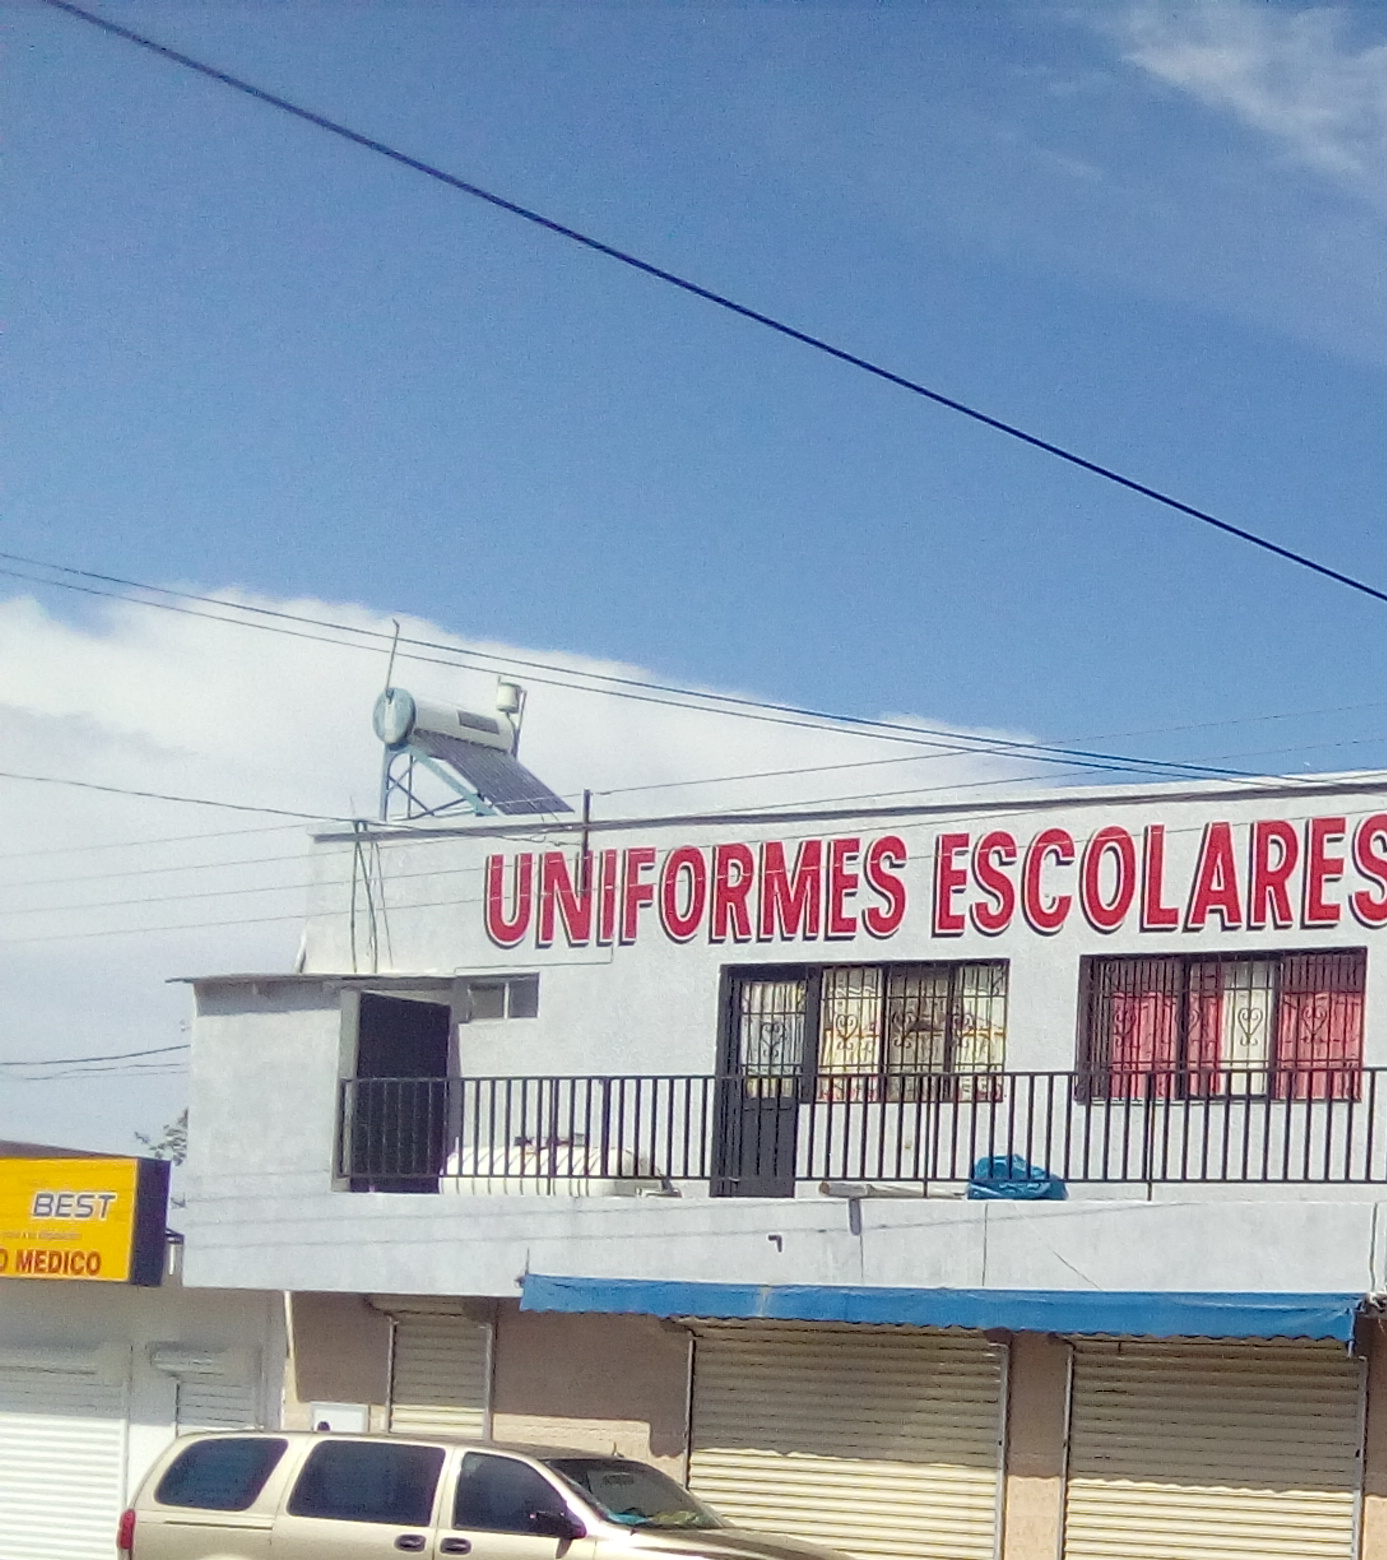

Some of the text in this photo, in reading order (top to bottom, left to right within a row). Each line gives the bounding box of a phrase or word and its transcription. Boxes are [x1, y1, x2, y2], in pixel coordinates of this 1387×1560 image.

[484, 835, 907, 949] UNIFORMES
[33, 1192, 117, 1219] BEST
[16, 1250, 102, 1276] MEDICO
